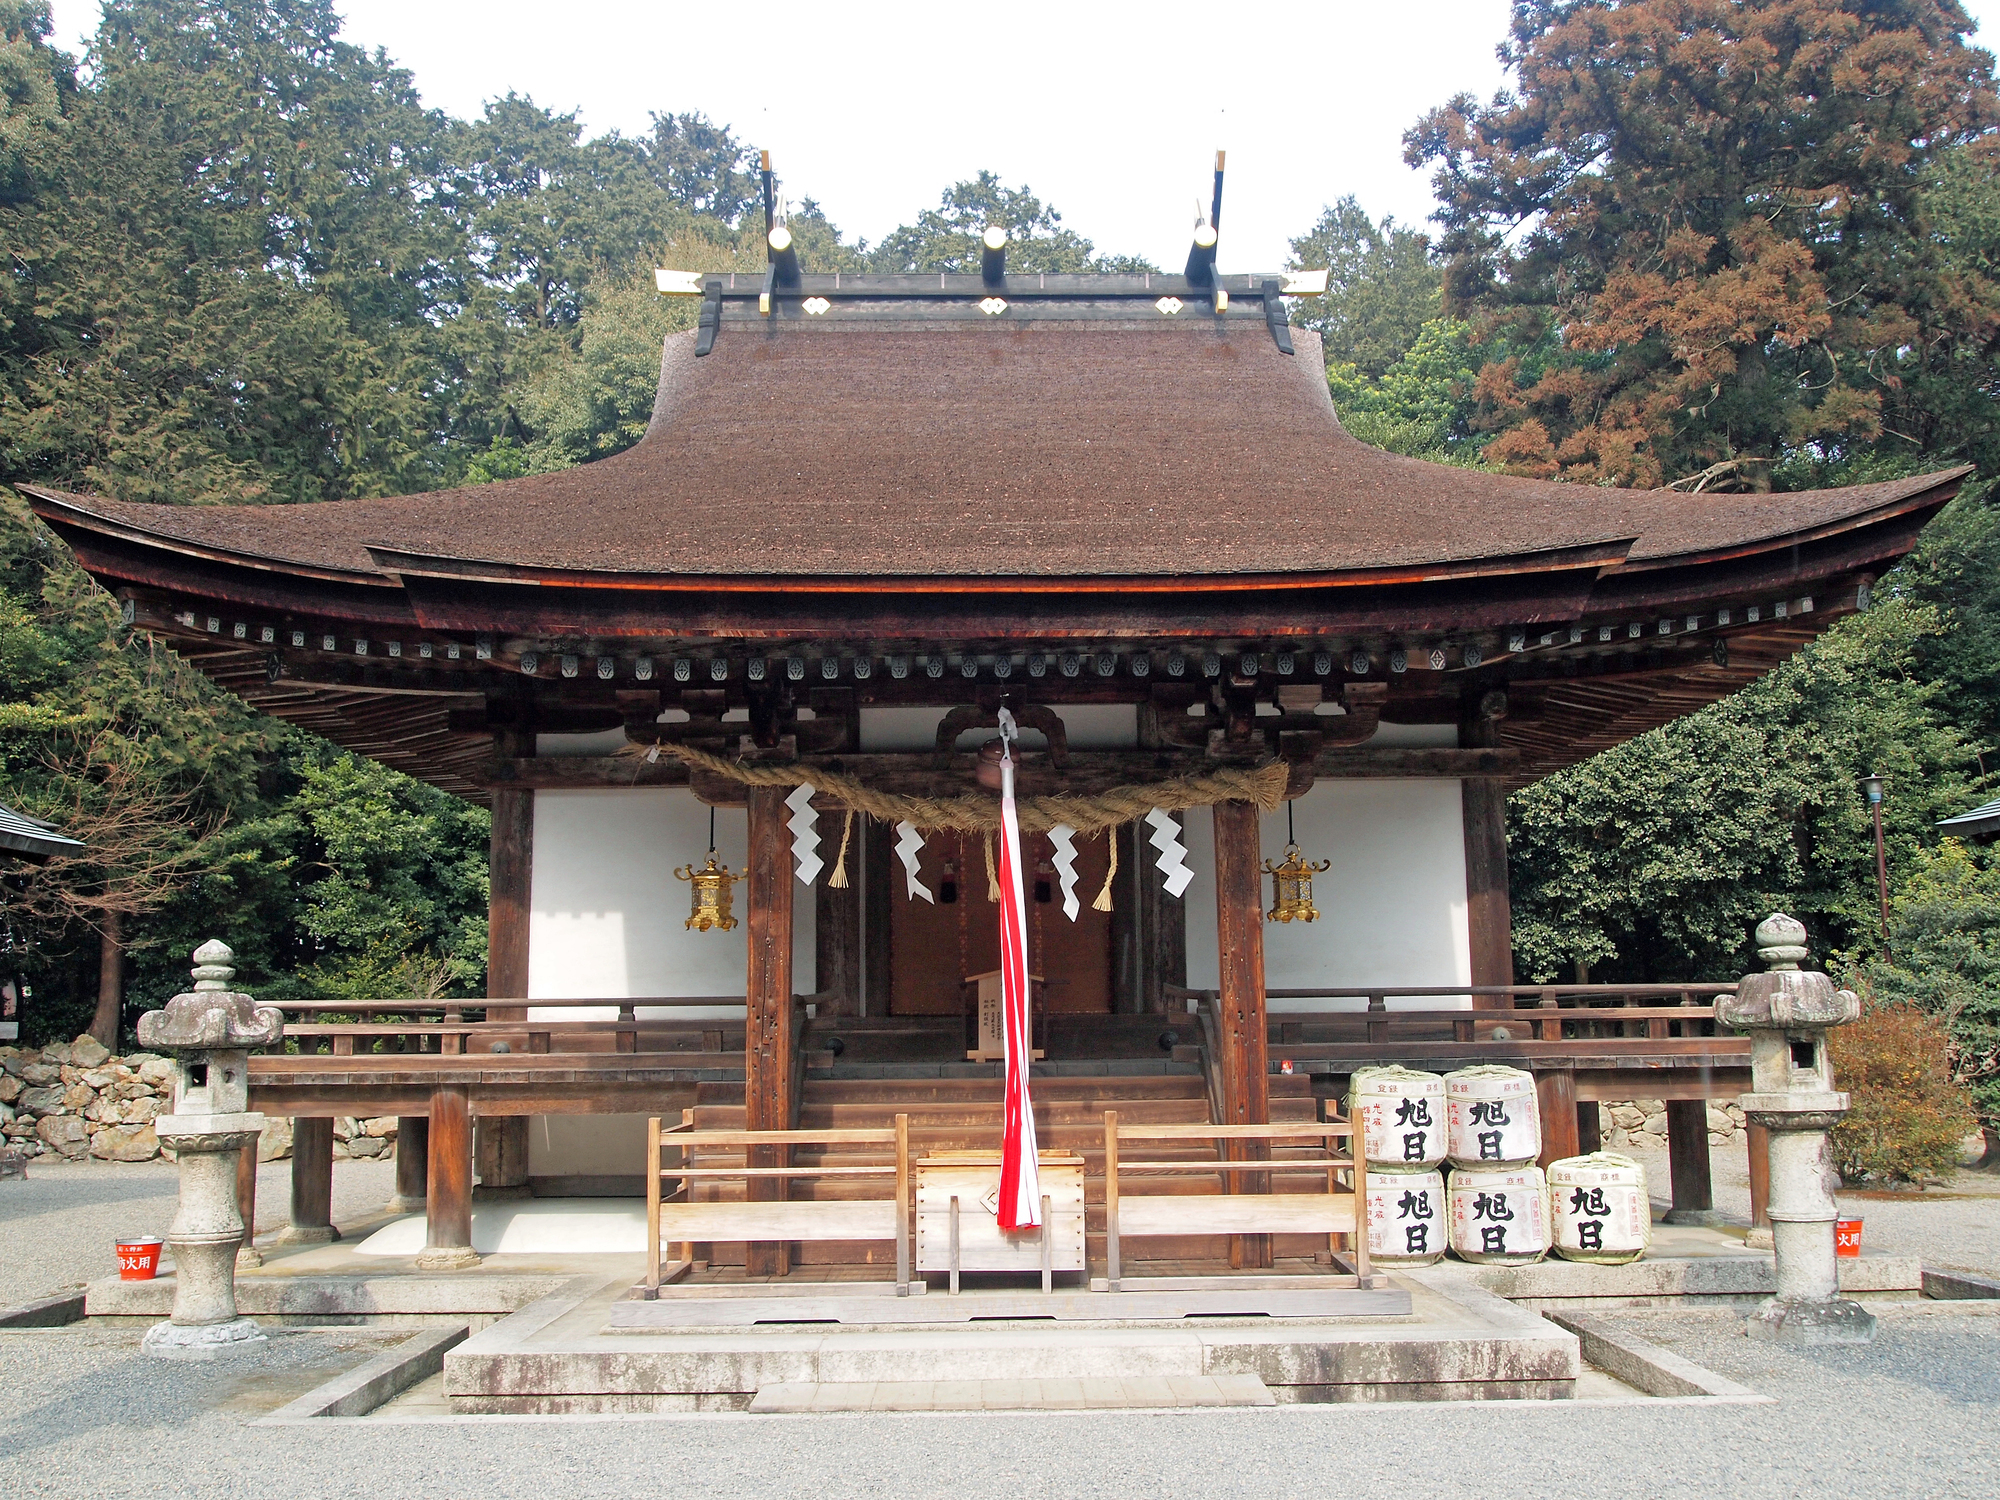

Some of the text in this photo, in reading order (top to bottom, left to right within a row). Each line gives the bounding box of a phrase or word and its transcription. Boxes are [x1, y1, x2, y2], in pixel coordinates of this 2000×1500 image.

[1395, 1098, 1432, 1161] 旭日
[1469, 1101, 1510, 1161] 旭日
[1397, 1190, 1433, 1254] 旭日
[1473, 1193, 1514, 1252] 旭日
[1570, 1187, 1611, 1250] 旭日
[117, 1256, 151, 1270] 防火用
